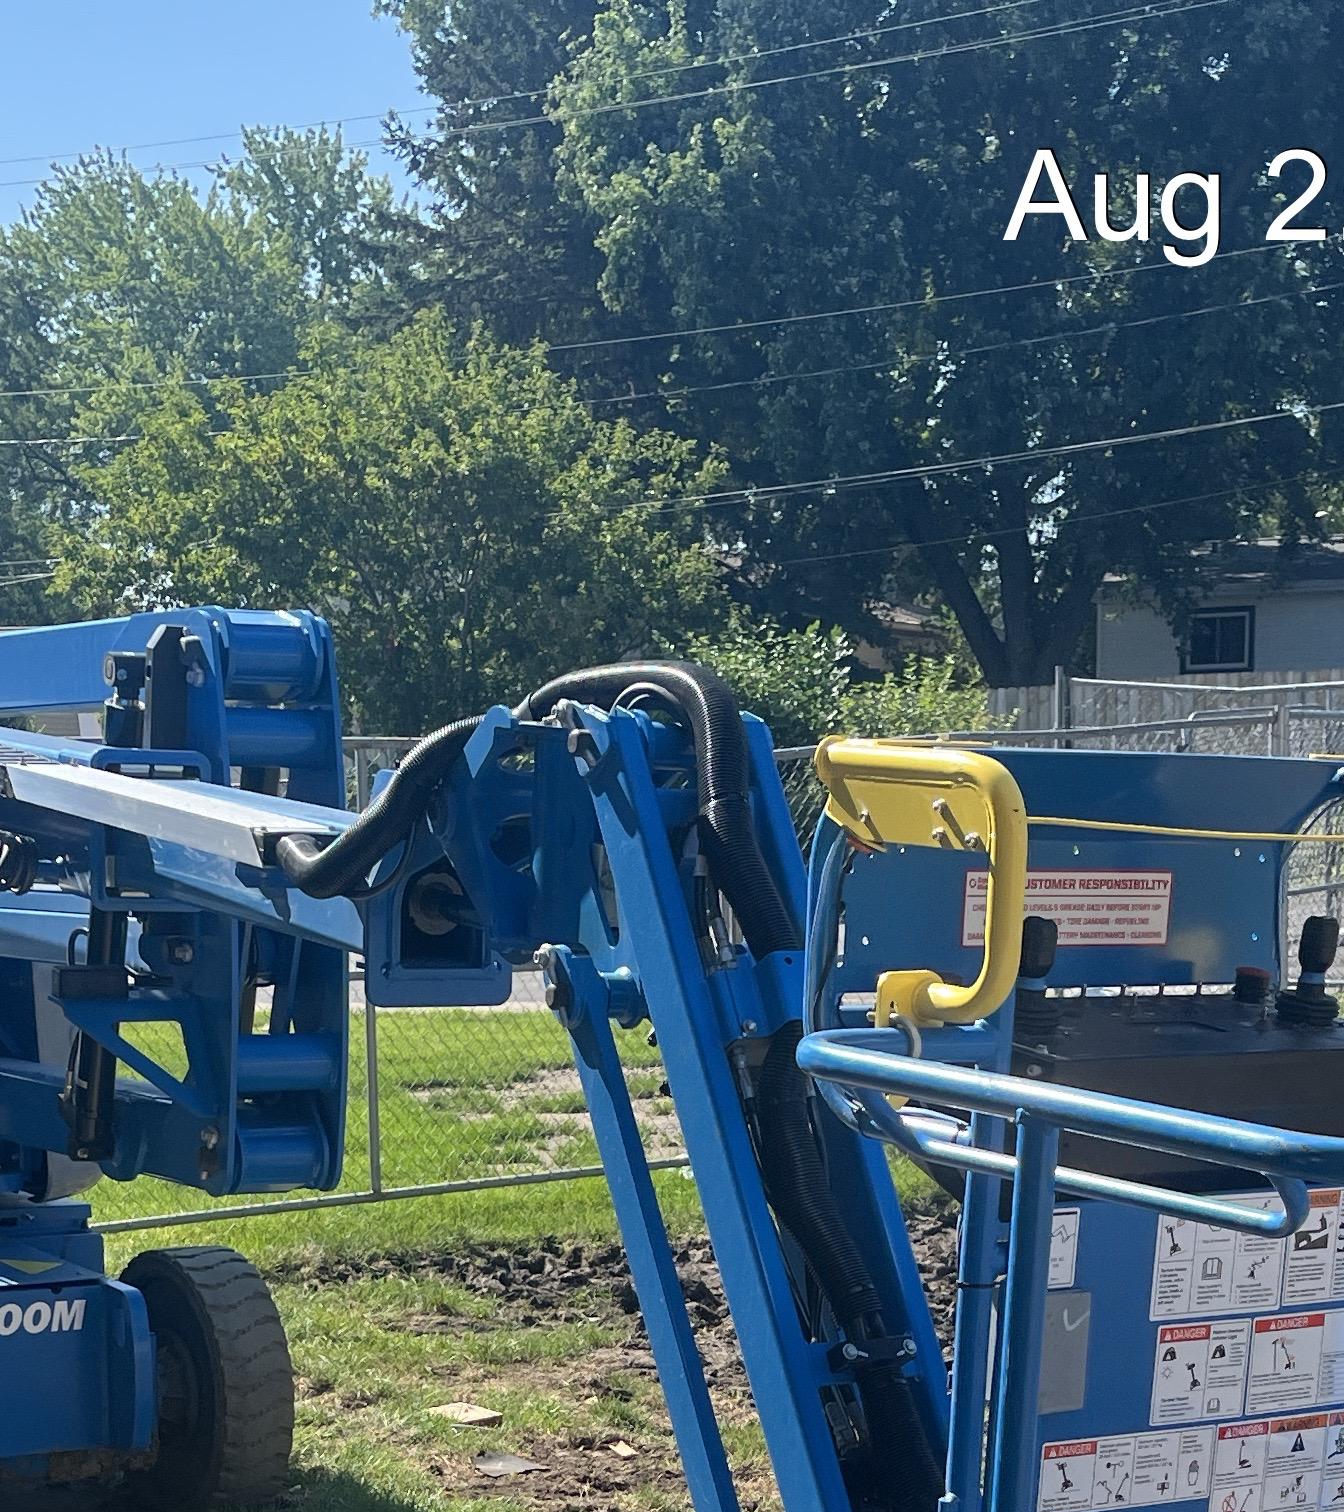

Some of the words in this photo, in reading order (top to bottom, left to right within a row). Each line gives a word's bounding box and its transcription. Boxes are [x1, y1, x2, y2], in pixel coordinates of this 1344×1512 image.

[1024, 878, 1077, 890] USTOMER
[1078, 878, 1170, 891] RESPONSIBILITY
[1276, 1316, 1309, 1330] DANGER
[1173, 1327, 1207, 1340] DANGER
[1232, 1423, 1264, 1438] DANGER
[1058, 1443, 1092, 1457] DANGER
